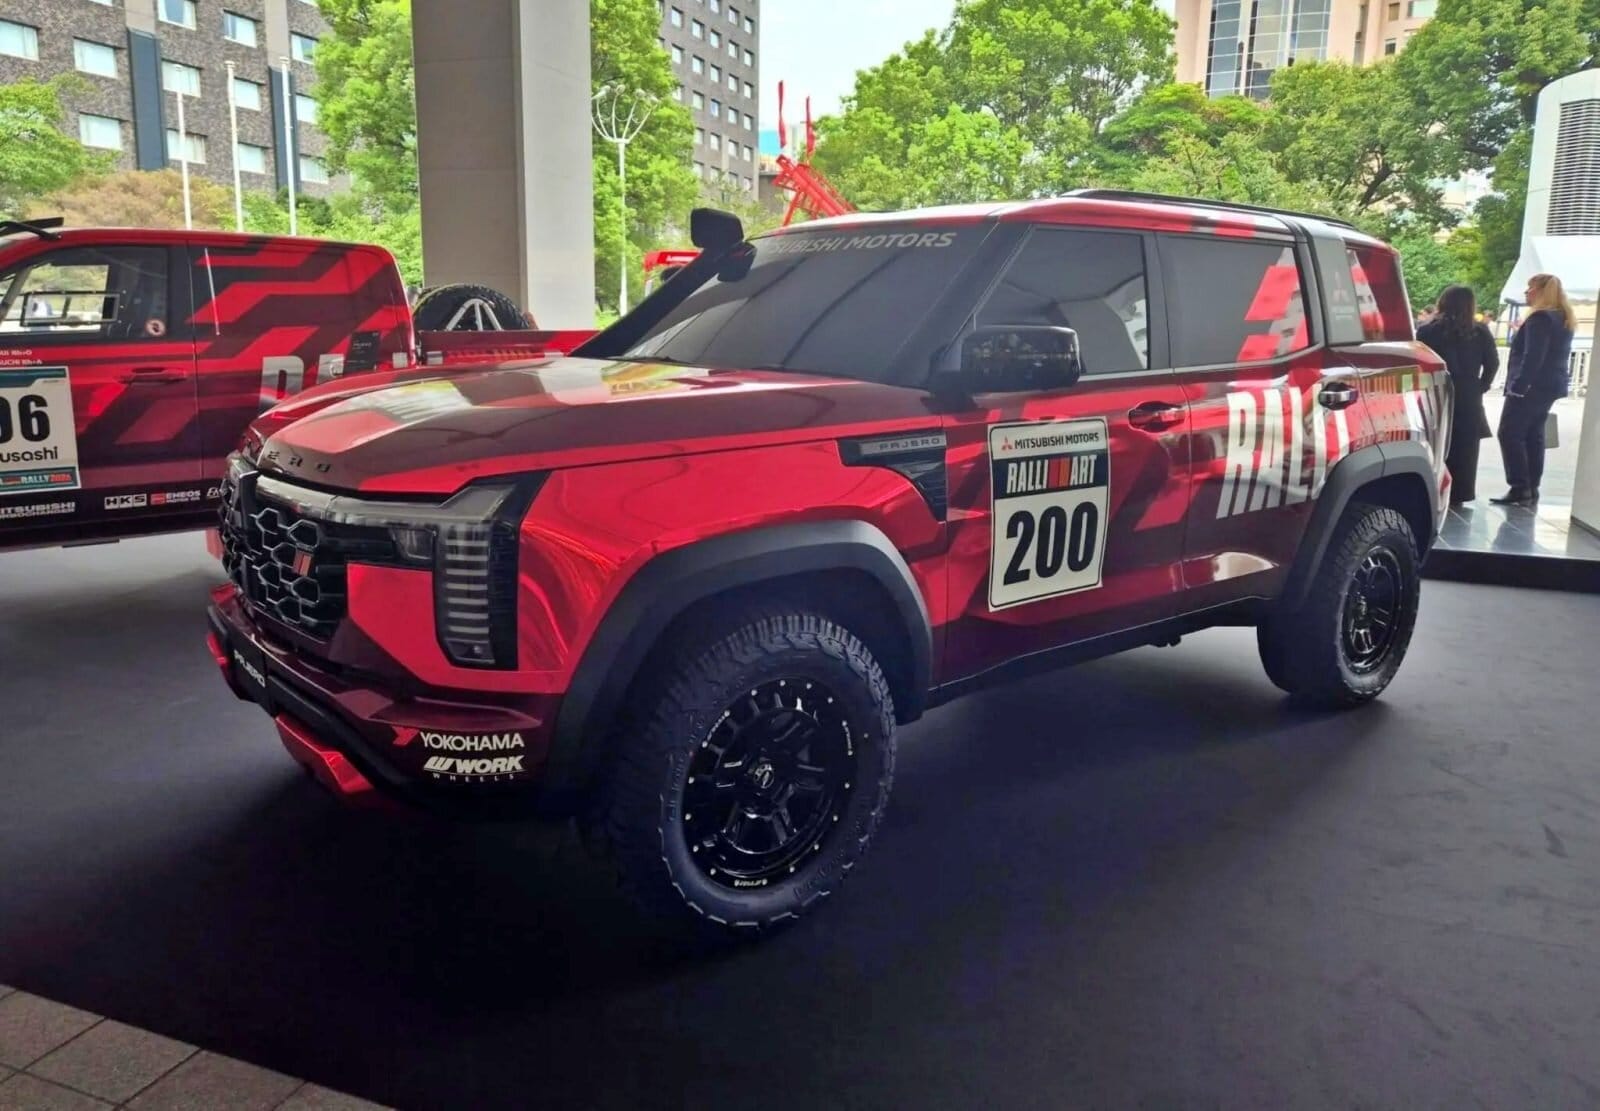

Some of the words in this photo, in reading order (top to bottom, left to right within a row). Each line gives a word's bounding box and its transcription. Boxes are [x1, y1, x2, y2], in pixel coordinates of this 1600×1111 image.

[843, 232, 957, 250] MOTORS
[1014, 437, 1064, 450] MITSUBISHI
[1065, 432, 1099, 444] MOTORS
[104, 494, 147, 510] HKS
[1003, 501, 1098, 586] 200
[420, 731, 525, 751] YOKOHAMA
[455, 755, 525, 773] WORK
